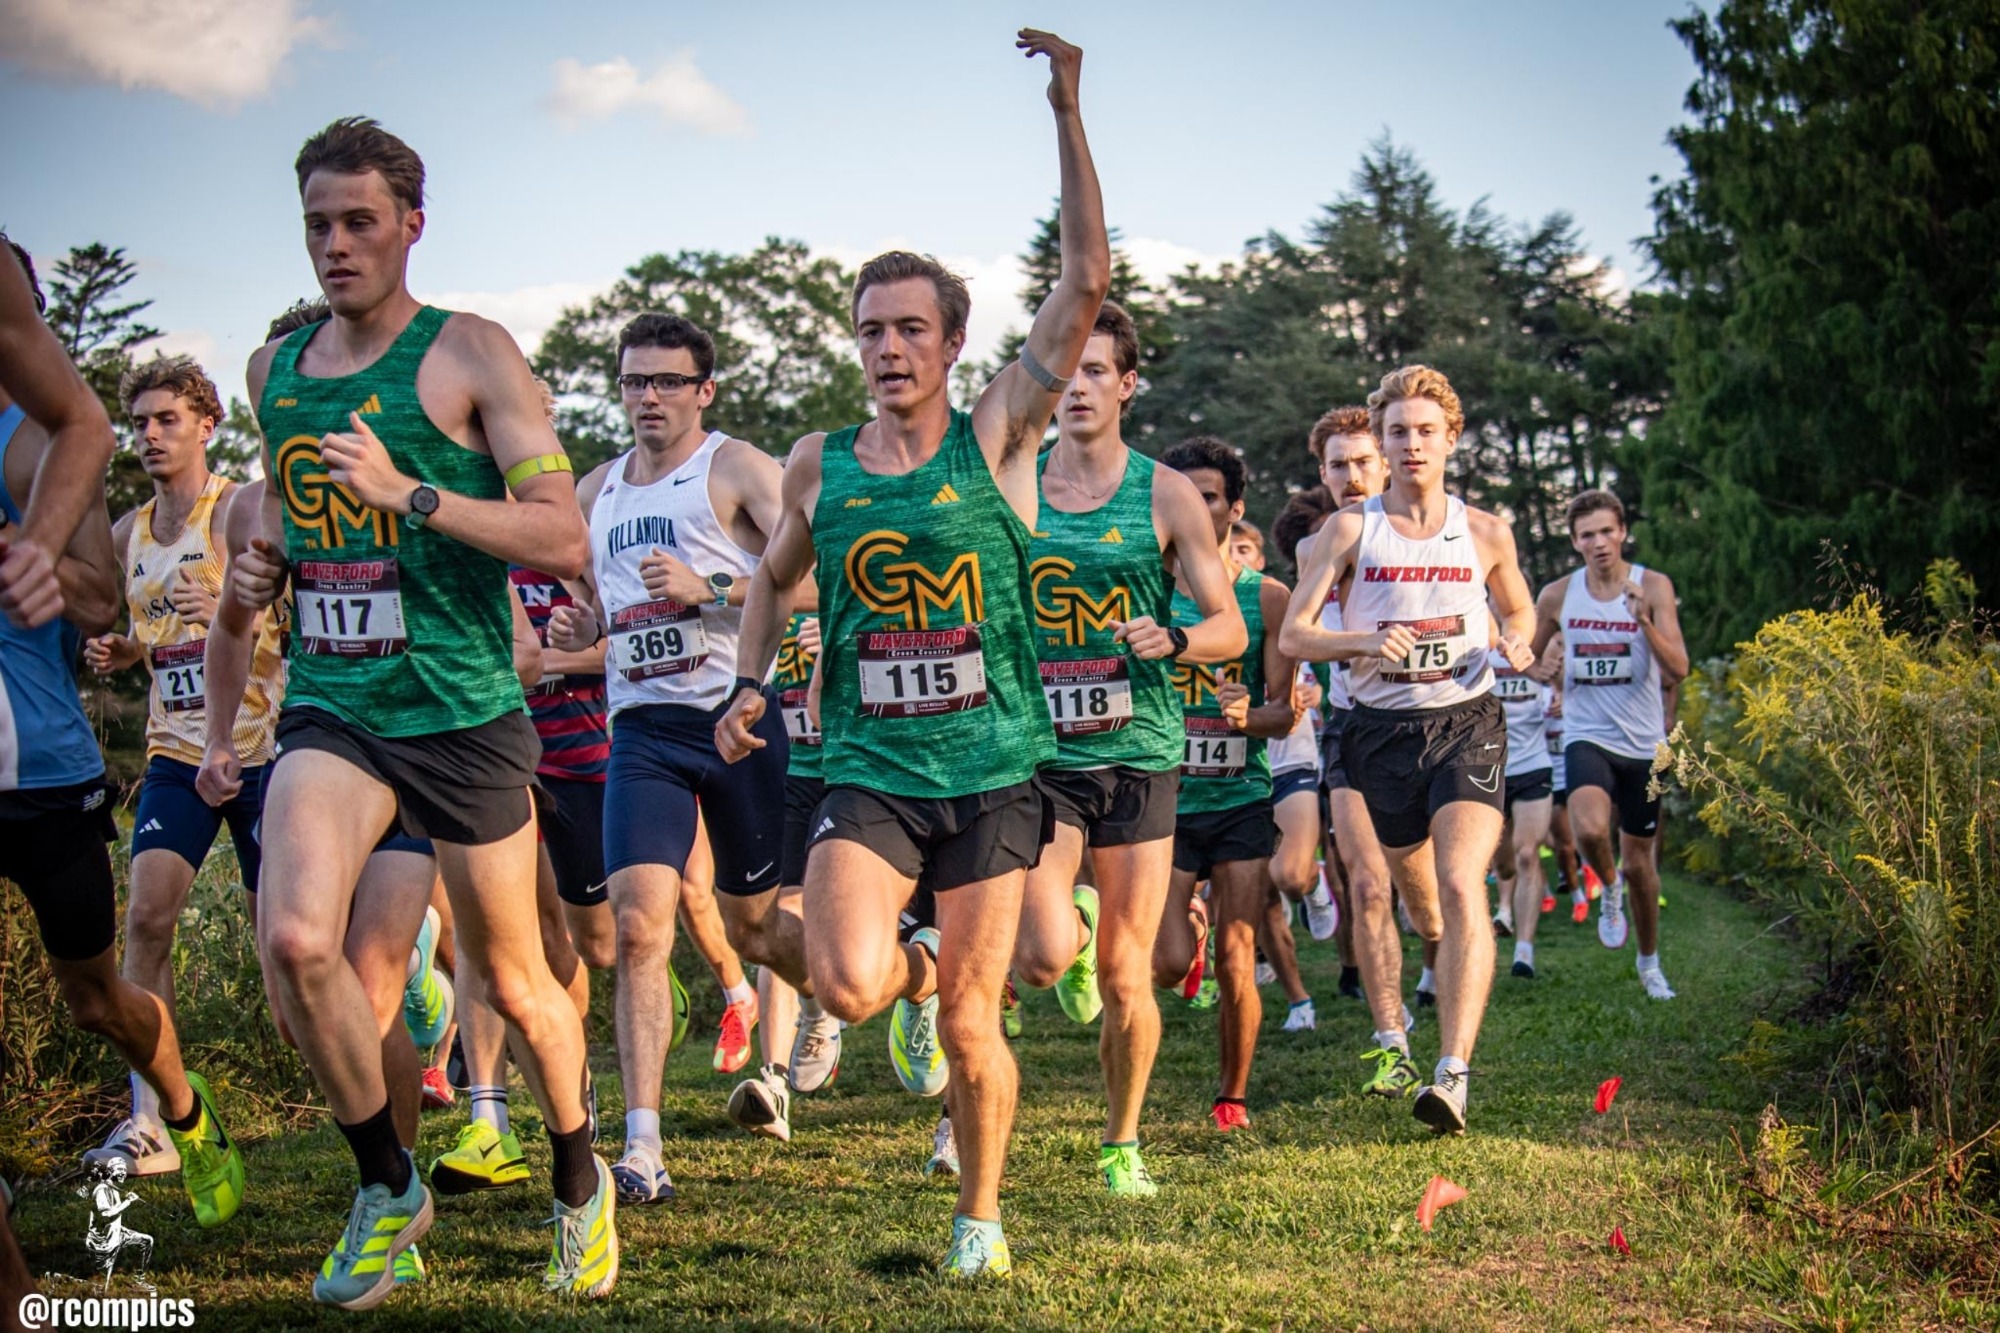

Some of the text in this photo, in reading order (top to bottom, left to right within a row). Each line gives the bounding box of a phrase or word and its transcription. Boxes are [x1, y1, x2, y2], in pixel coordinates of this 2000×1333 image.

[276, 434, 399, 550] GM
[608, 516, 677, 558] VILLANOVA
[301, 561, 384, 581] HAVERFORD
[845, 529, 984, 631] GM
[1363, 566, 1473, 583] HAVERFORD
[318, 581, 367, 591] Cross Country
[615, 600, 687, 626] HAVERFORD
[1029, 556, 1130, 647] GM
[315, 597, 372, 636] 117
[630, 615, 676, 629] Cross Country
[1567, 618, 1640, 634] HAVERFORD
[156, 640, 206, 662] HAVERFOR
[628, 627, 684, 664] 369
[868, 628, 967, 651] HAVERFORD
[891, 648, 951, 657] Cross Country
[1038, 658, 1118, 677] HAVERFORD
[1585, 659, 1618, 677] 187
[885, 661, 958, 699] 115
[1501, 679, 1528, 694] 174
[1048, 686, 1109, 719] 118
[1185, 739, 1228, 764] 114
